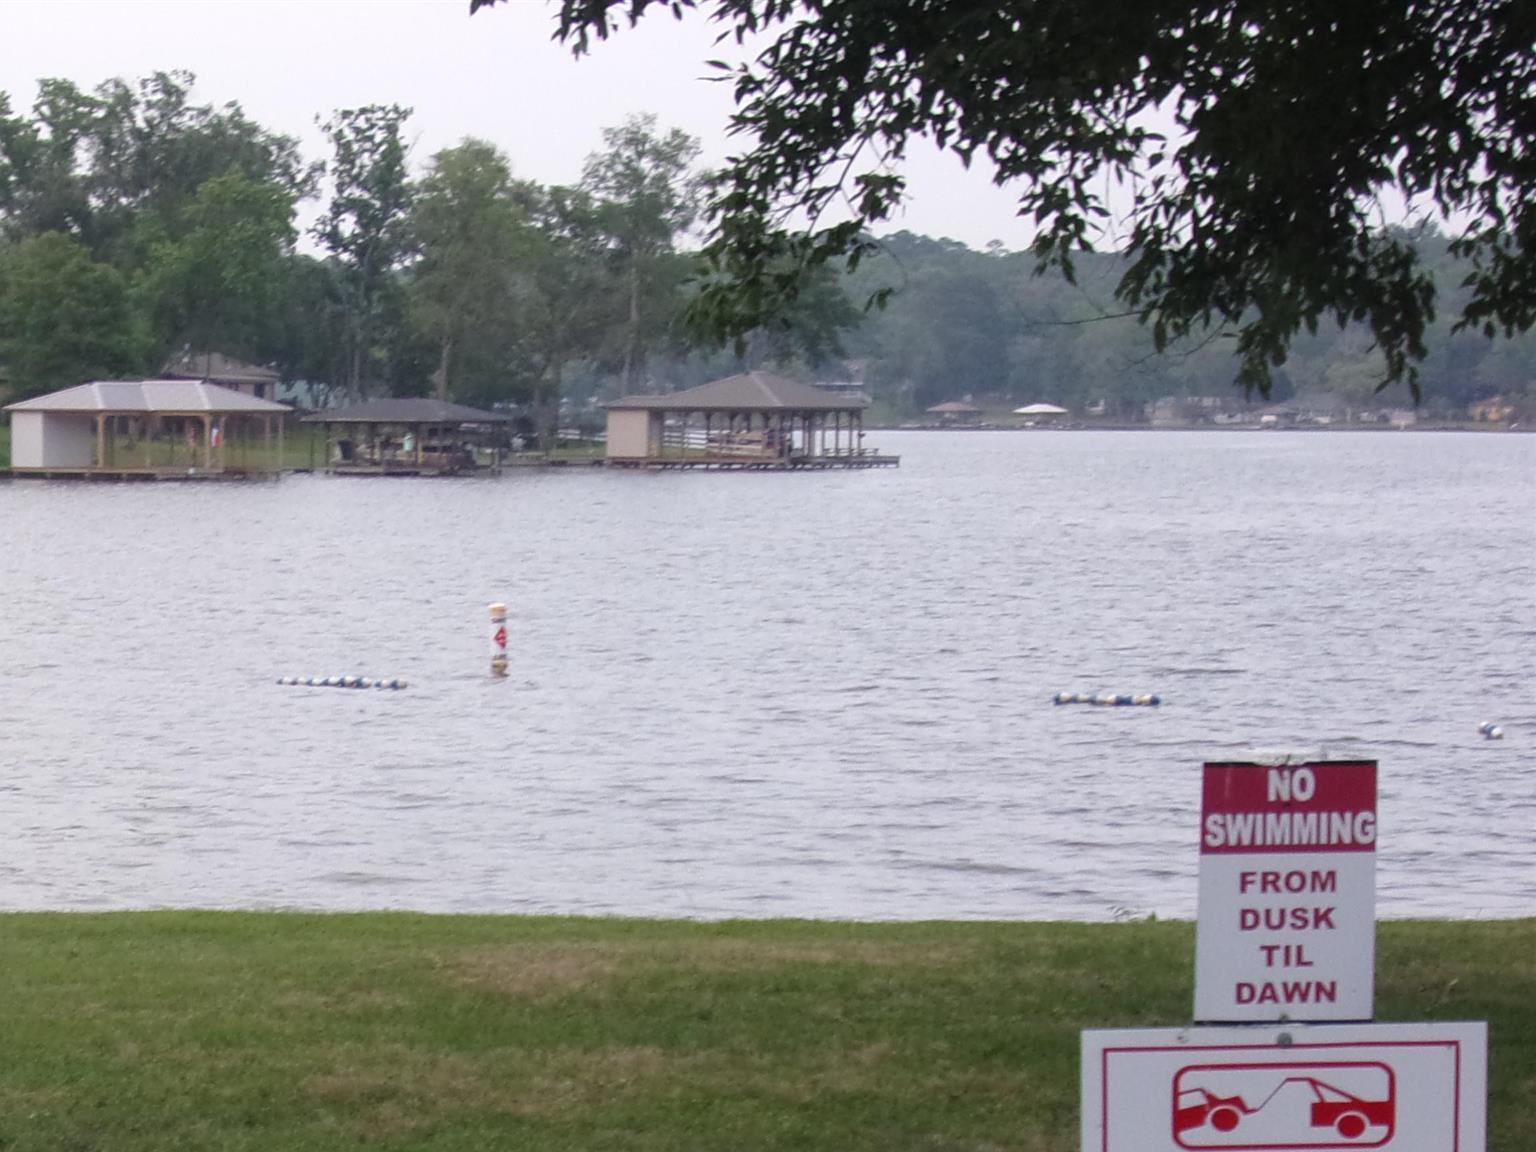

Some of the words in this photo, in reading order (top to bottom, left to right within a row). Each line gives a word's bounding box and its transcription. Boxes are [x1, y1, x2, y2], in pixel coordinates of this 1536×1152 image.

[1267, 769, 1315, 802] NO
[1205, 811, 1376, 847] SWIMMING
[1239, 870, 1337, 894] FROM
[1239, 907, 1337, 931] DUSK
[1260, 945, 1314, 967] TIL
[1235, 981, 1337, 1004] DAWN
